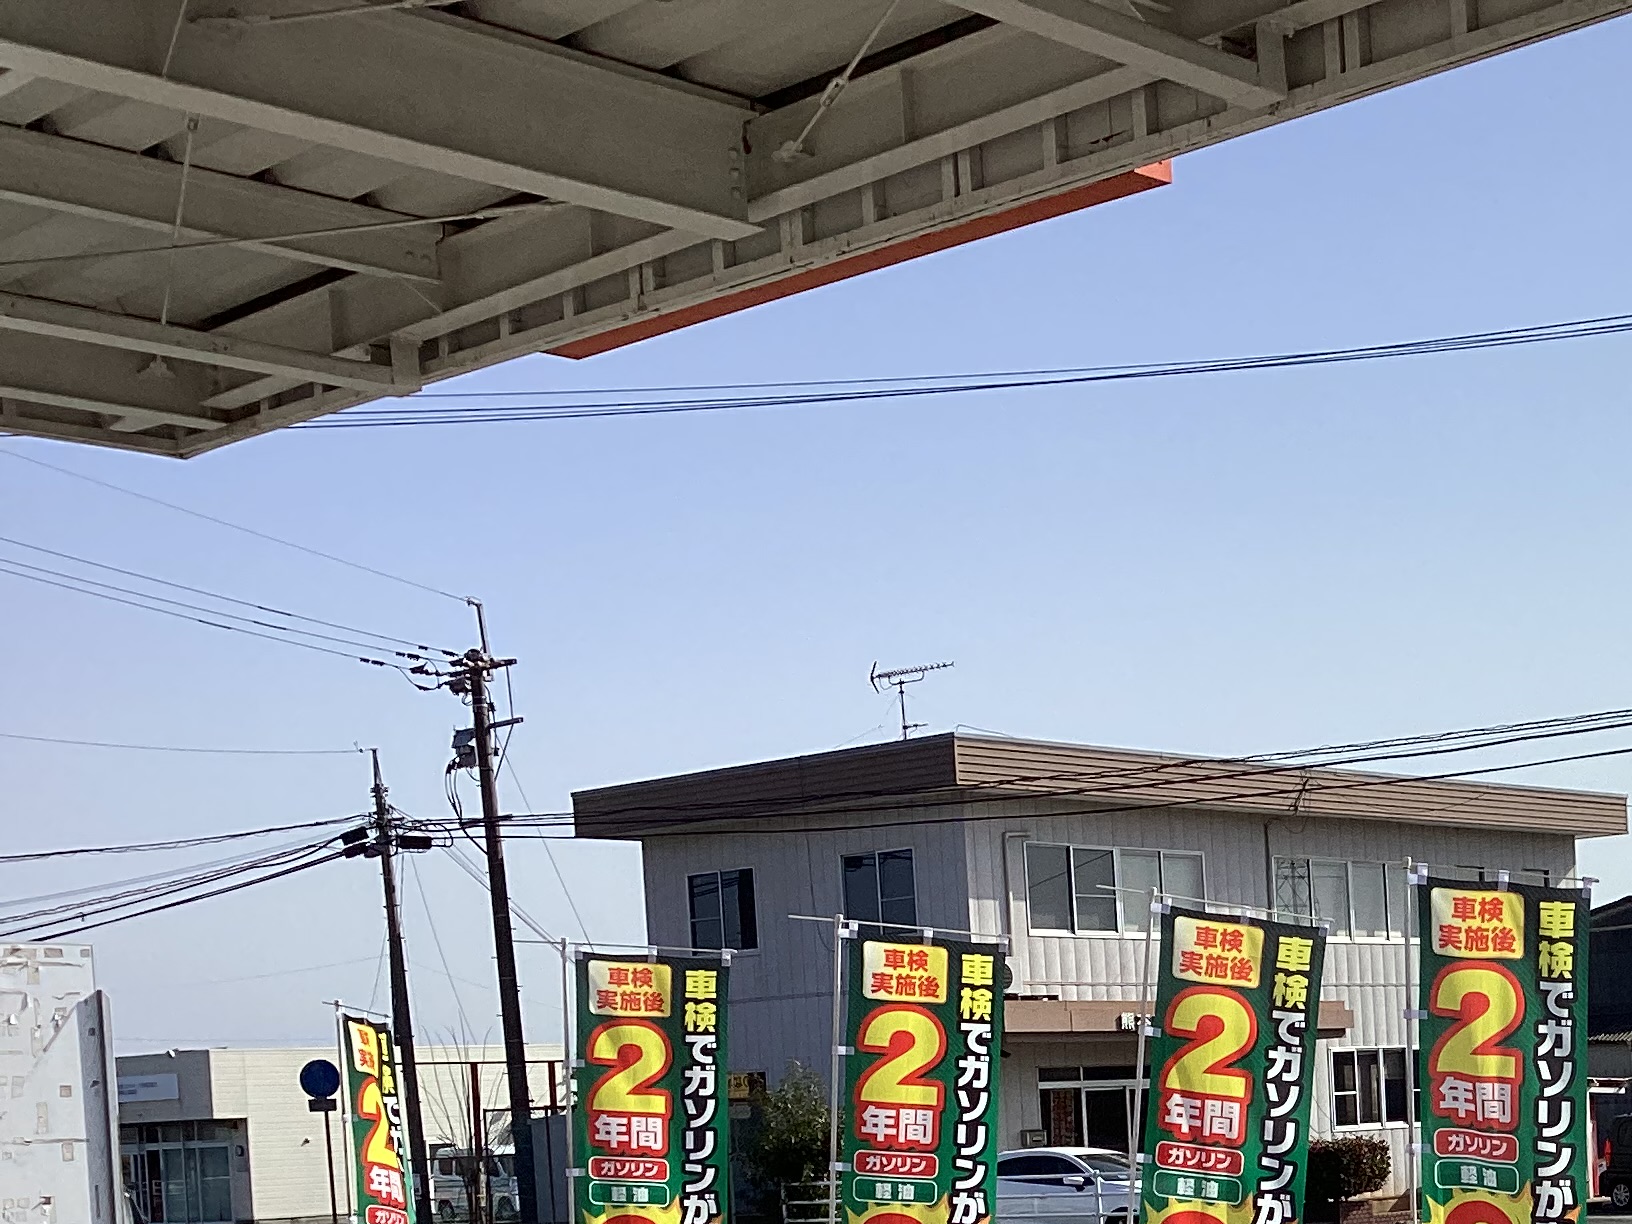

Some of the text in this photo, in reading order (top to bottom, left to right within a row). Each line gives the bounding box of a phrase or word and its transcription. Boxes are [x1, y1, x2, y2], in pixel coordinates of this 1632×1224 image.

[1452, 897, 1503, 923] 車検
[1194, 927, 1244, 953] 車検
[1438, 925, 1516, 954] 実施後
[884, 949, 929, 972] 車検
[1180, 951, 1254, 982] 実施後
[607, 967, 653, 988] 車検
[871, 973, 940, 999] 実施後
[1437, 968, 1517, 1079] 2
[862, 1010, 939, 1105] 2
[1167, 992, 1250, 1098] 2
[592, 1025, 666, 1114] 2
[1439, 1078, 1512, 1124] 年間
[362, 1082, 399, 1168] 2
[861, 1108, 933, 1143] 年間
[1164, 1095, 1240, 1139] 年間
[594, 1116, 663, 1149] 年間
[1448, 1134, 1508, 1156] ガソリン
[600, 1162, 659, 1176] ガソリン
[866, 1155, 926, 1173] ガソリン
[1168, 1148, 1231, 1169] ガソリン
